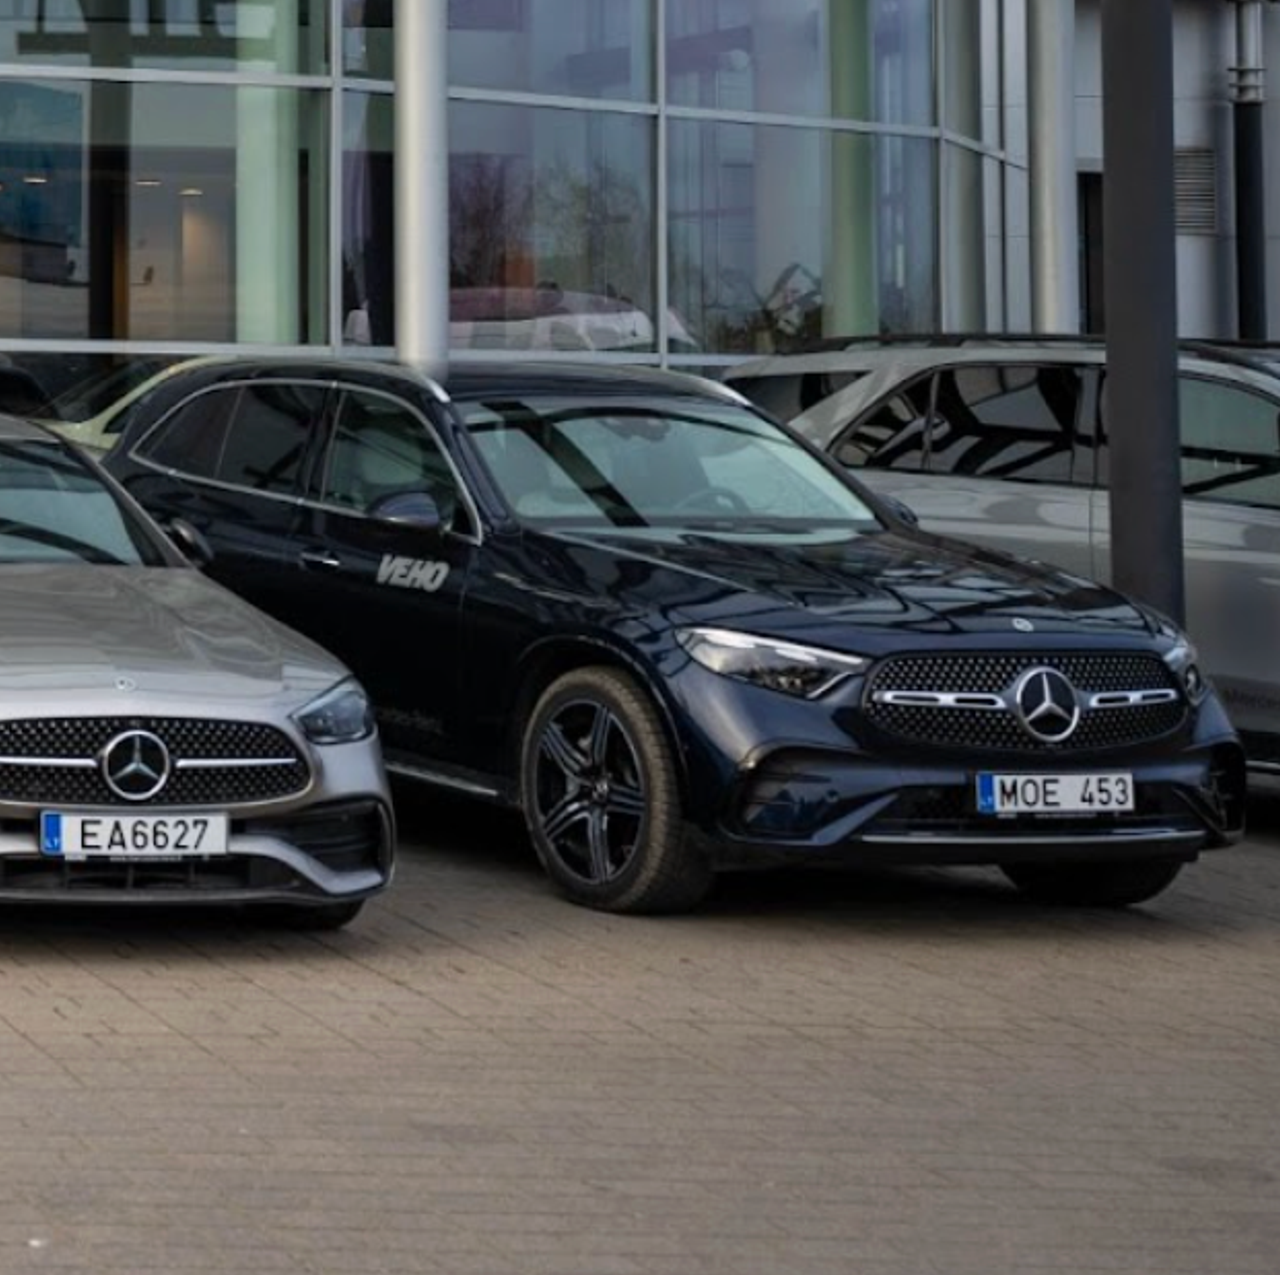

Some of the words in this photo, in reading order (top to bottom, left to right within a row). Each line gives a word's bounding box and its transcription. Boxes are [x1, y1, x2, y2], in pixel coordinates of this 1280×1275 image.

[376, 553, 450, 593] VEHO
[999, 778, 1061, 807] MOE
[1080, 777, 1130, 806] 453
[80, 819, 209, 851] EA6627
